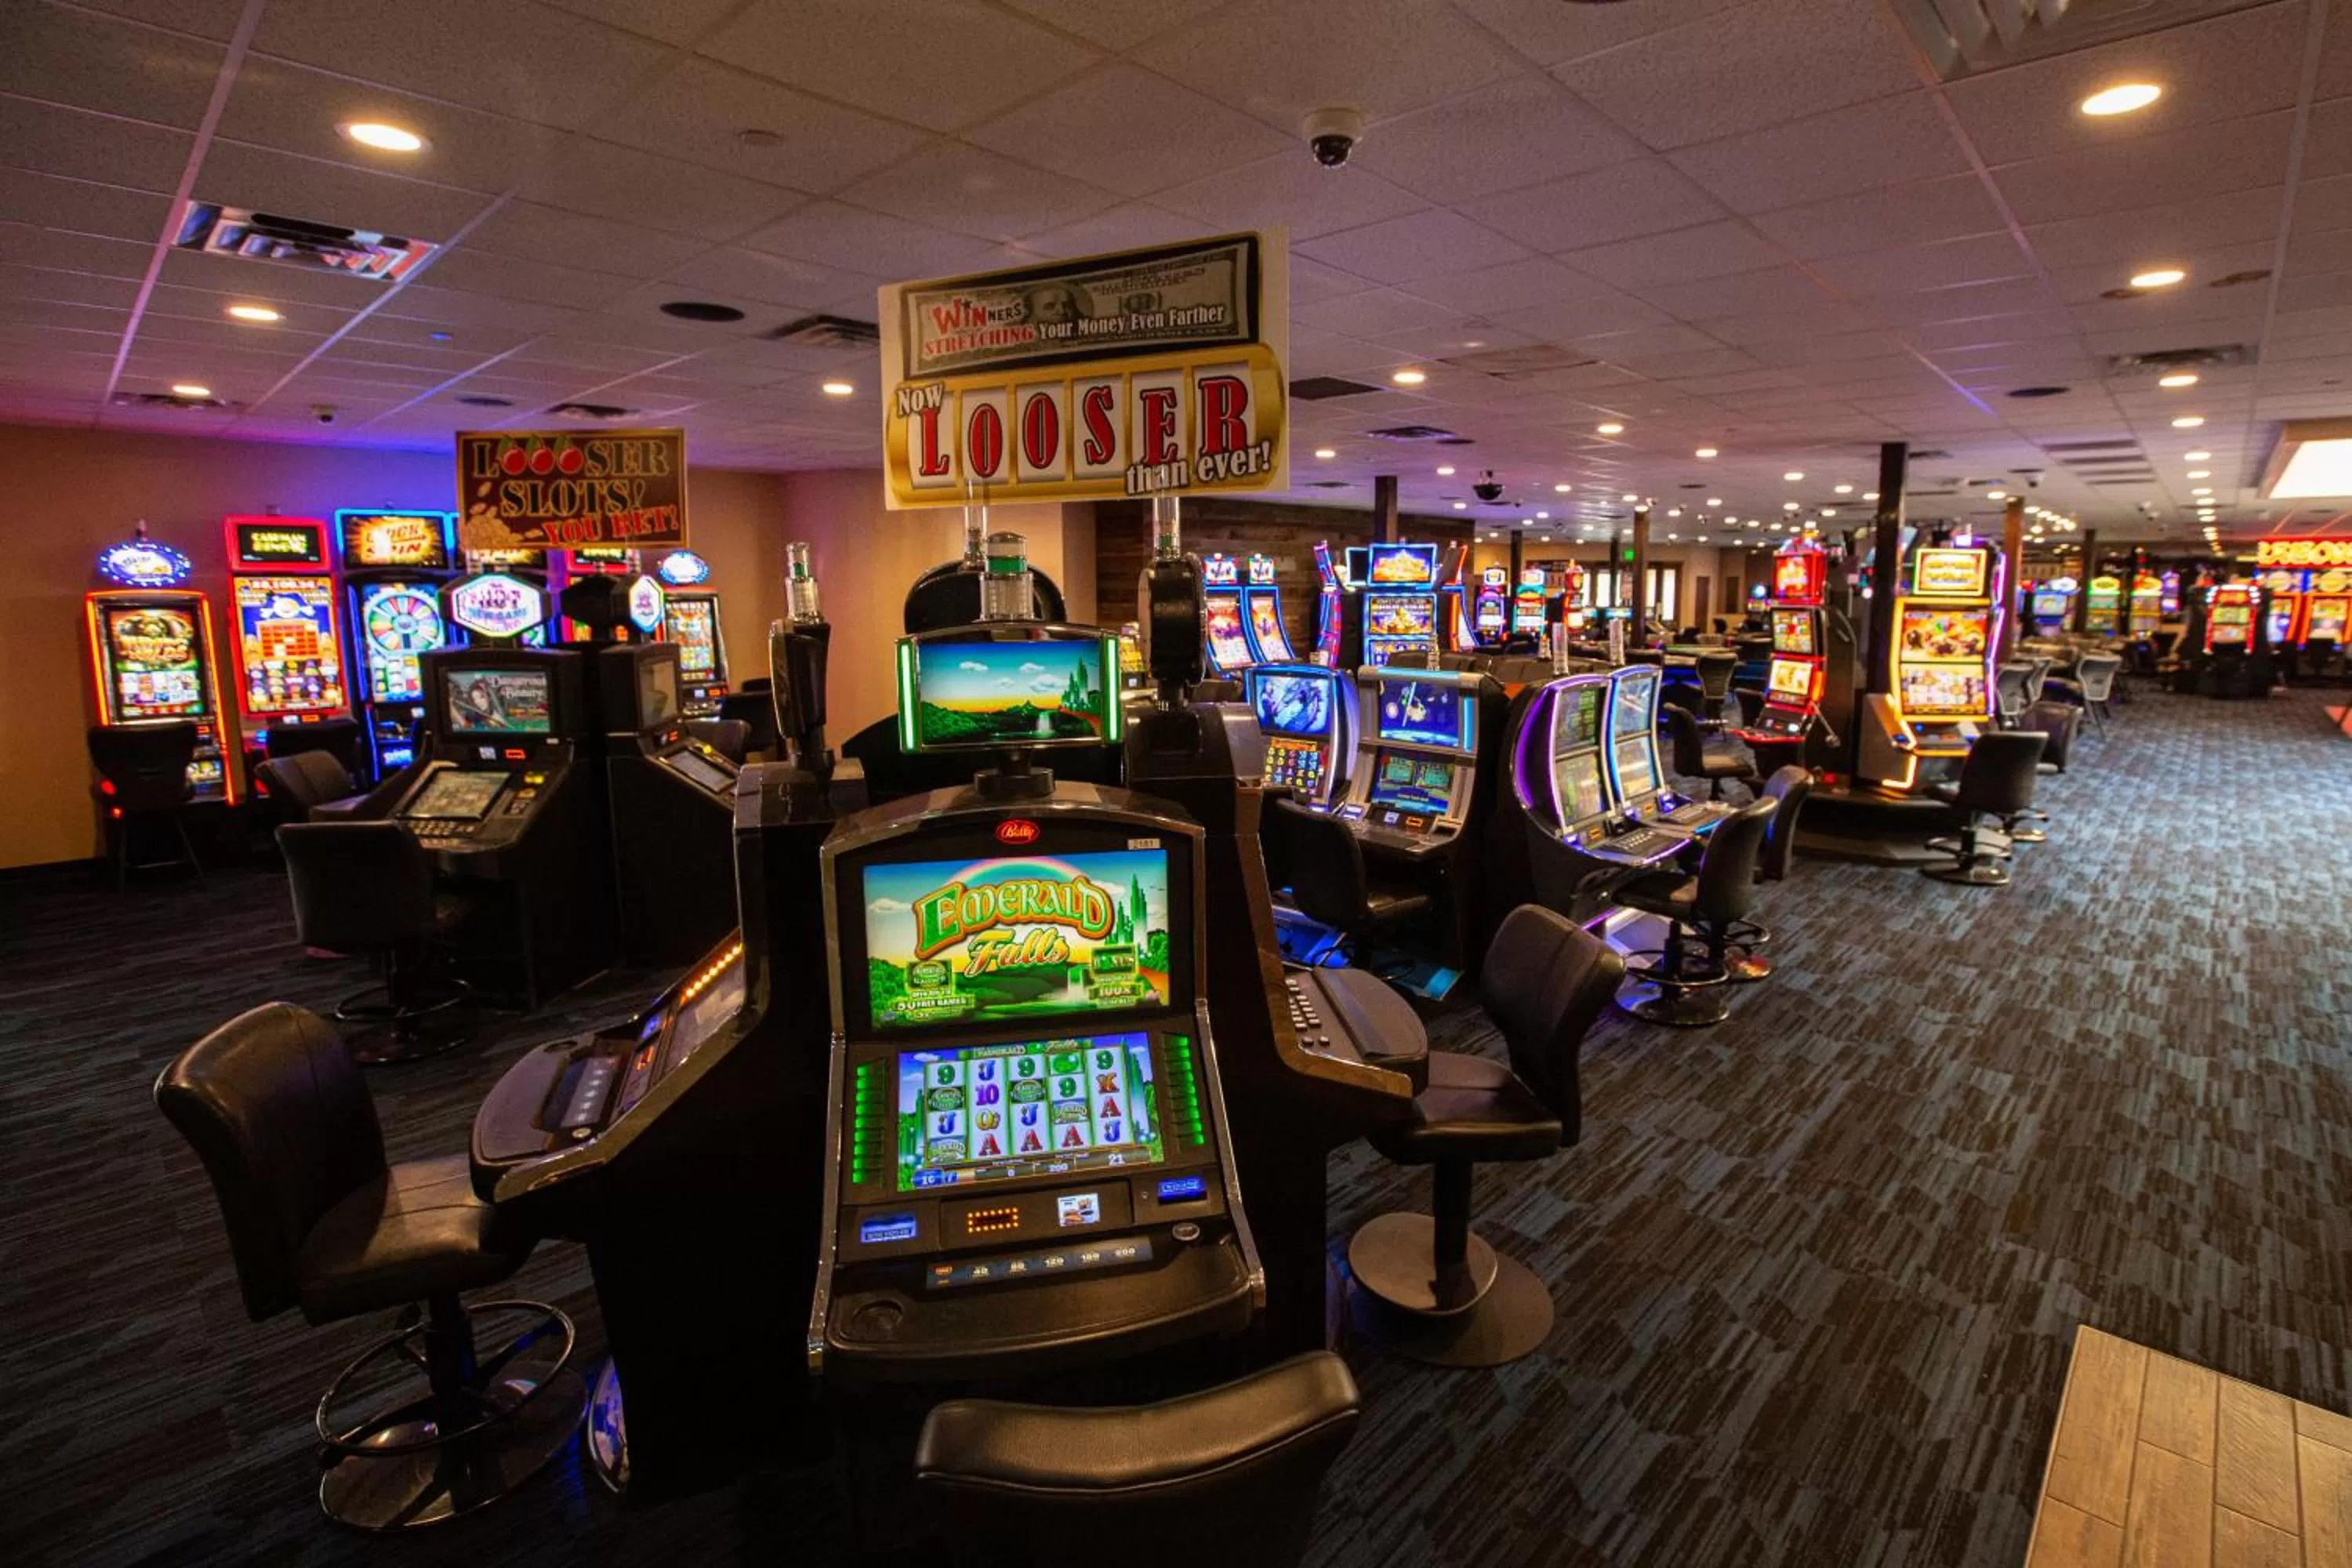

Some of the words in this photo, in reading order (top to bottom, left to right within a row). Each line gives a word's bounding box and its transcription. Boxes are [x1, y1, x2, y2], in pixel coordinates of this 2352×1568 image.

[924, 327, 1034, 354] STRETCHING
[1038, 322, 1073, 340] Your
[1077, 315, 1127, 336] Money
[1131, 313, 1164, 330] Even
[1169, 305, 1225, 326] Farther
[919, 376, 1248, 478] LOOSER
[1126, 459, 1189, 495] than
[1196, 441, 1271, 481] ever!
[499, 479, 646, 517] SLOTS!
[543, 514, 602, 545] YOU
[610, 504, 679, 539] BET!
[1005, 825, 1035, 840] Bally
[918, 878, 1110, 956] EMERALD
[964, 928, 1069, 978] Falls
[978, 1059, 996, 1081] J
[1018, 1056, 1036, 1077] 9
[1095, 1050, 1113, 1070] 9
[938, 1065, 956, 1086] 9
[1058, 1076, 1076, 1098] 9
[1096, 1072, 1120, 1095] K
[975, 1083, 1000, 1106] 10
[1020, 1103, 1039, 1126] J
[1099, 1096, 1122, 1119] A
[937, 1111, 956, 1134] J
[1103, 1120, 1121, 1142] J
[978, 1133, 1001, 1156] A
[1020, 1128, 1044, 1152] A
[1062, 1125, 1084, 1148] A
